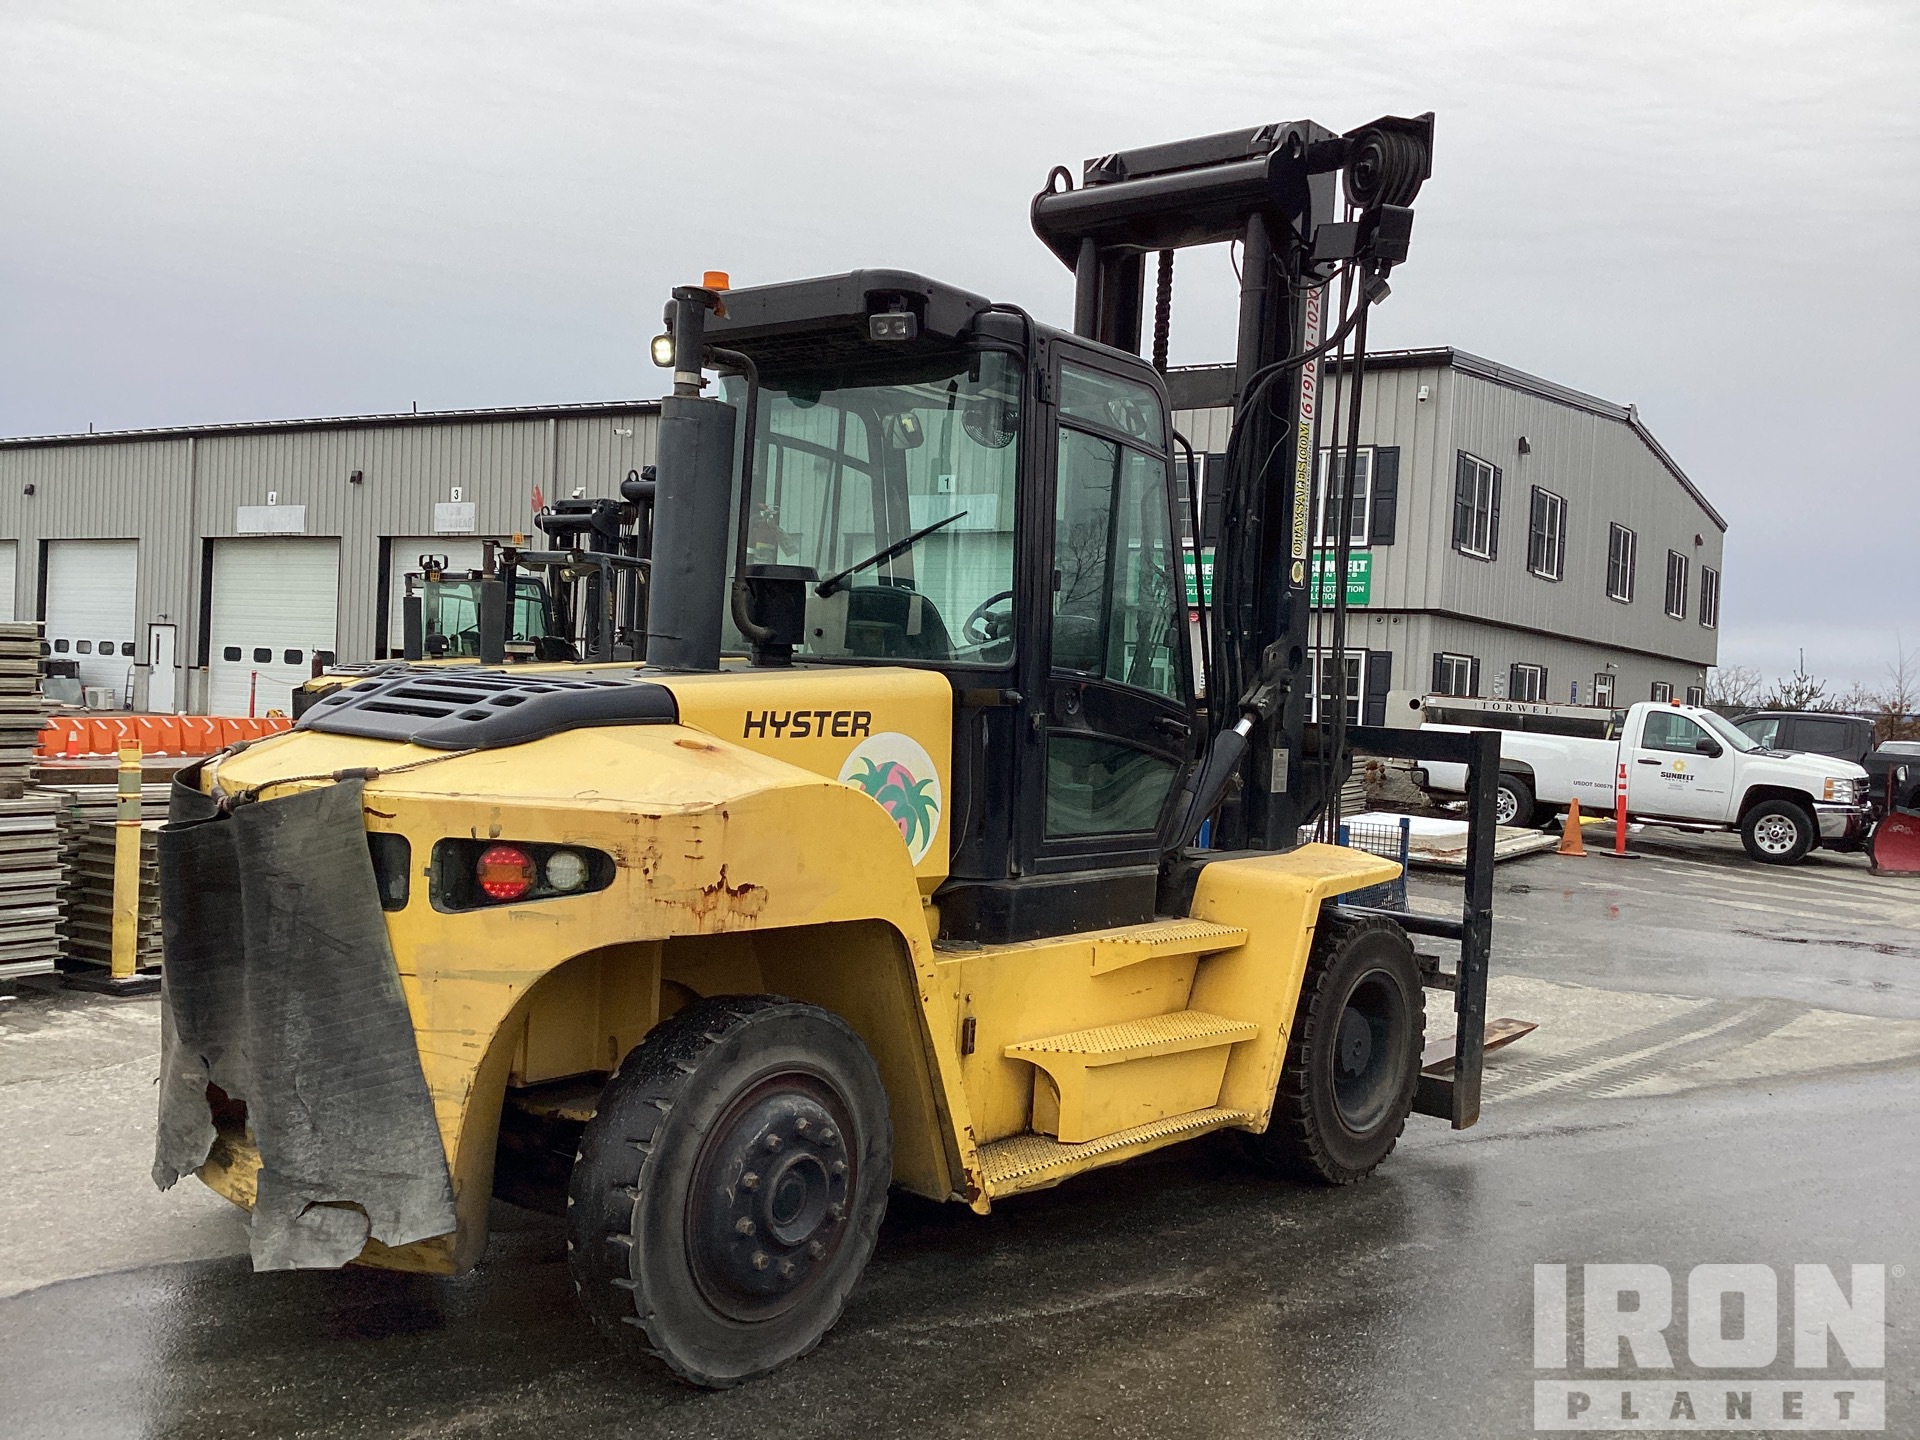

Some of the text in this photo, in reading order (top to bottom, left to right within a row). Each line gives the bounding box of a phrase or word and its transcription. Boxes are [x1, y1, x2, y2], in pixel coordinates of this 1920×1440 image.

[1300, 286, 1320, 421] (619)61-1020
[269, 493, 275, 504] 4
[453, 489, 459, 500] 3
[1480, 701, 1552, 715] TORWEL
[743, 711, 872, 738] HYSTER
[1660, 771, 1695, 781] SUNBELT
